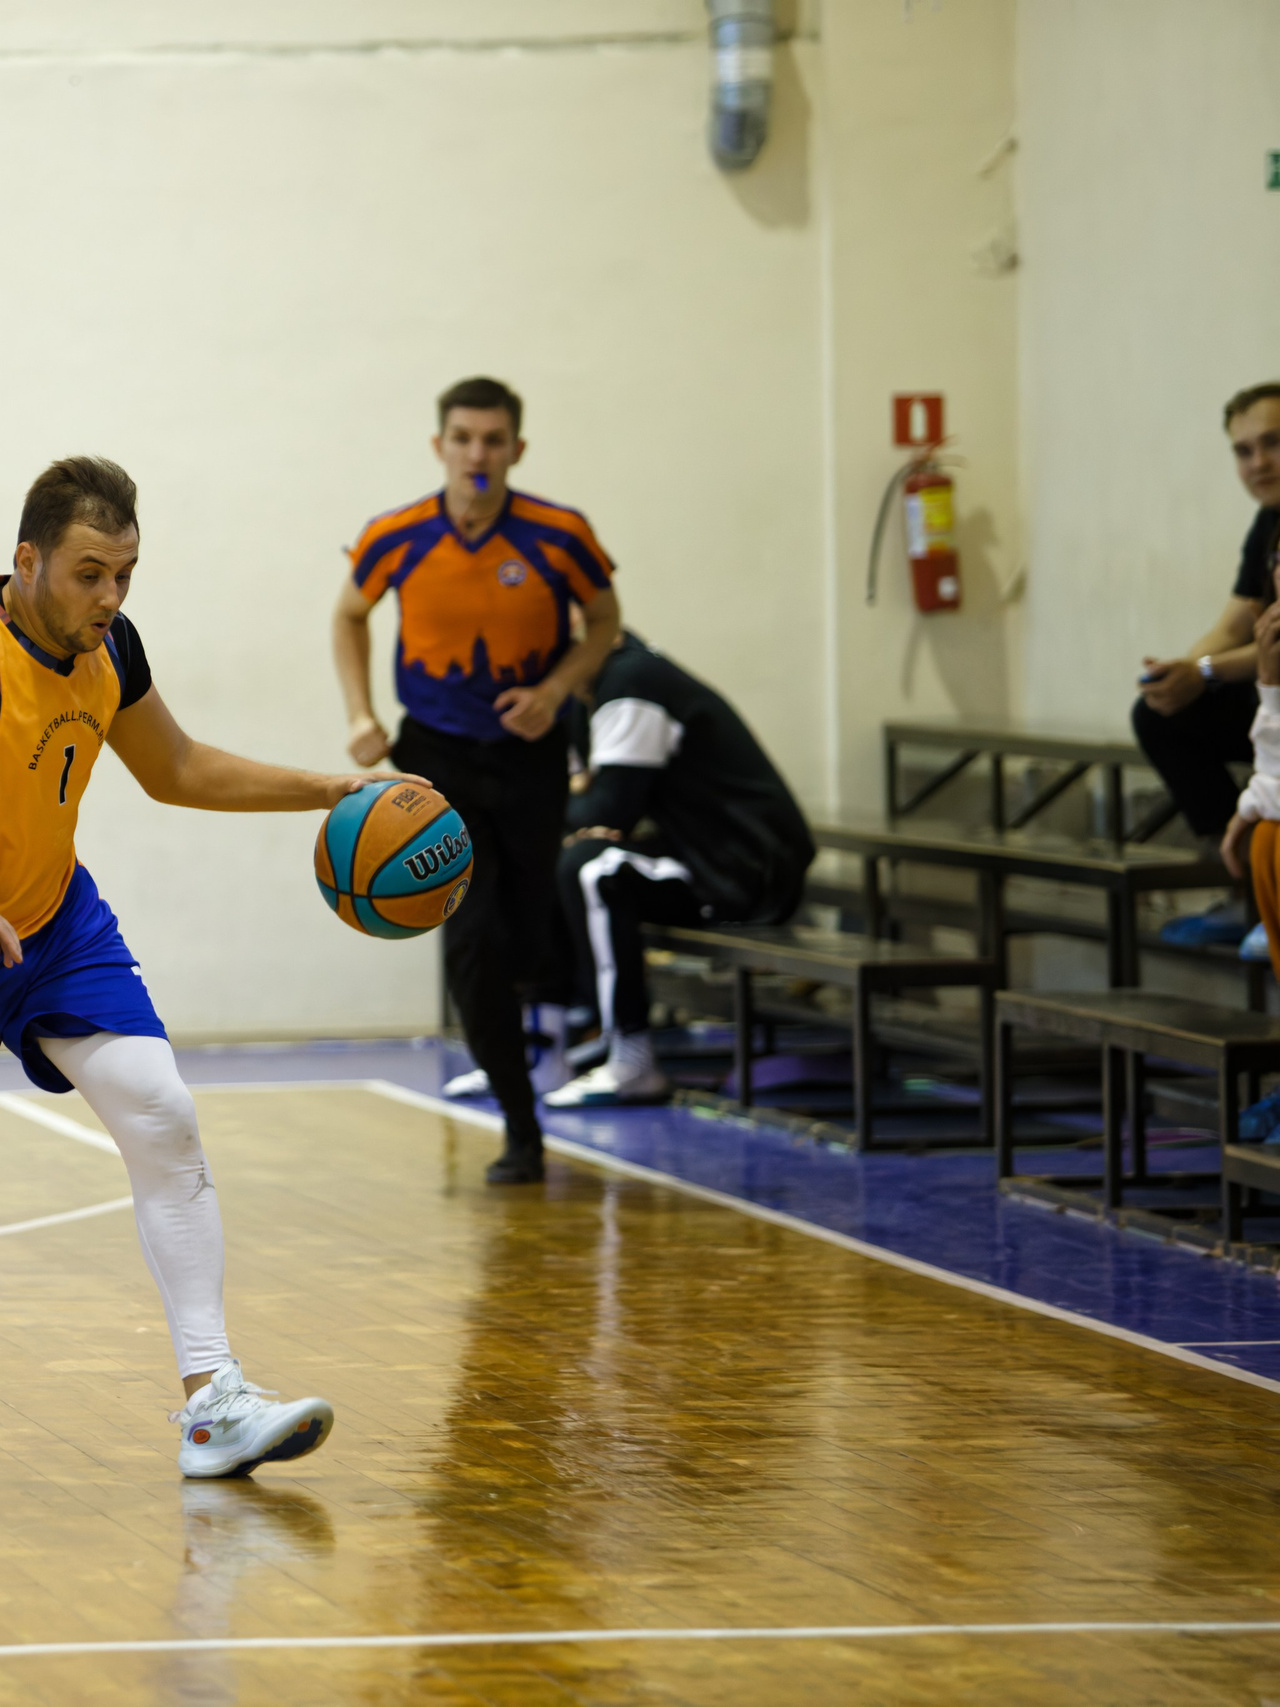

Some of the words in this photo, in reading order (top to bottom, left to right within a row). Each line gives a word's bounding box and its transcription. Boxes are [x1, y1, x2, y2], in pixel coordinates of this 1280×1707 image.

[59, 744, 76, 806] 1
[392, 788, 420, 809] FIBA
[402, 825, 470, 881] Wilso
